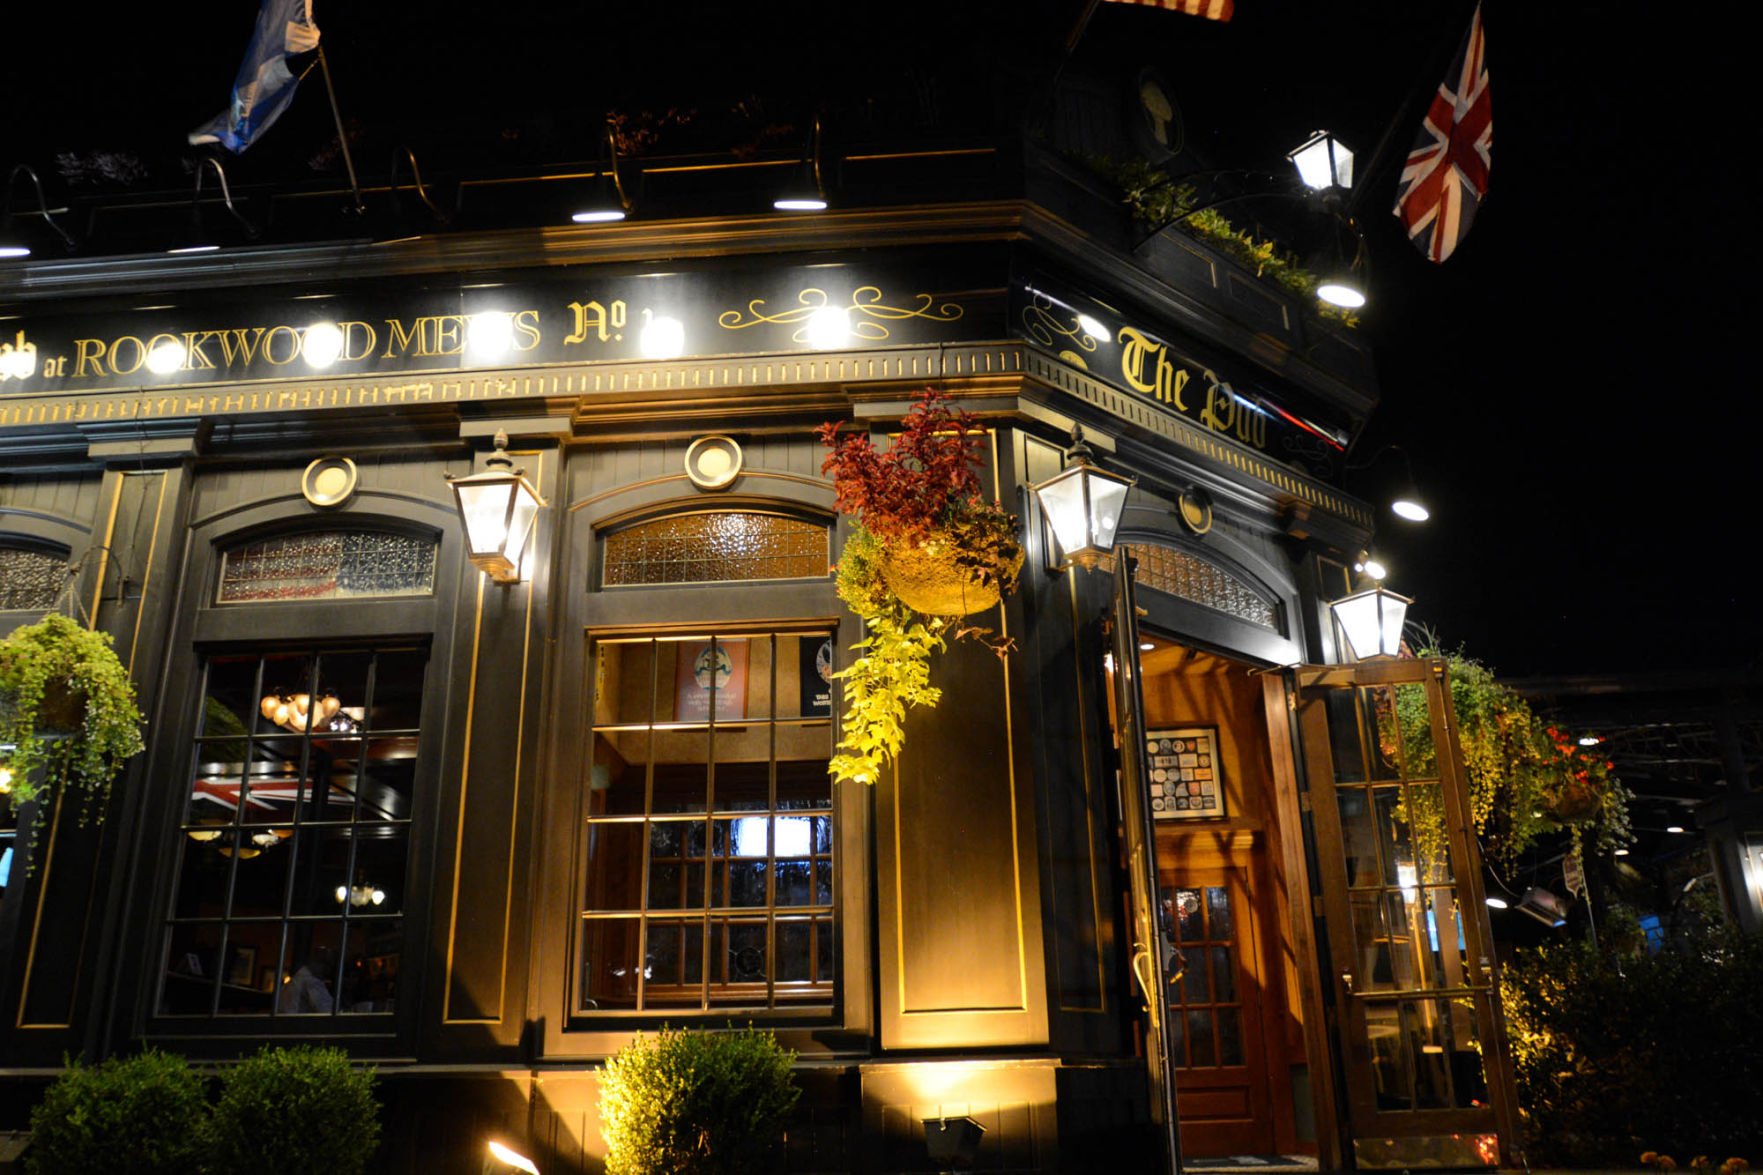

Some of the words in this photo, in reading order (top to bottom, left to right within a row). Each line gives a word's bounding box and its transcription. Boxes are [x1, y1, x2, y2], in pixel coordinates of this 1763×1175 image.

[43, 355, 68, 378] at
[71, 321, 377, 378] ROOKWOD
[381, 310, 541, 358] MES
[1118, 326, 1190, 412] The
[1201, 369, 1267, 448] Pub
